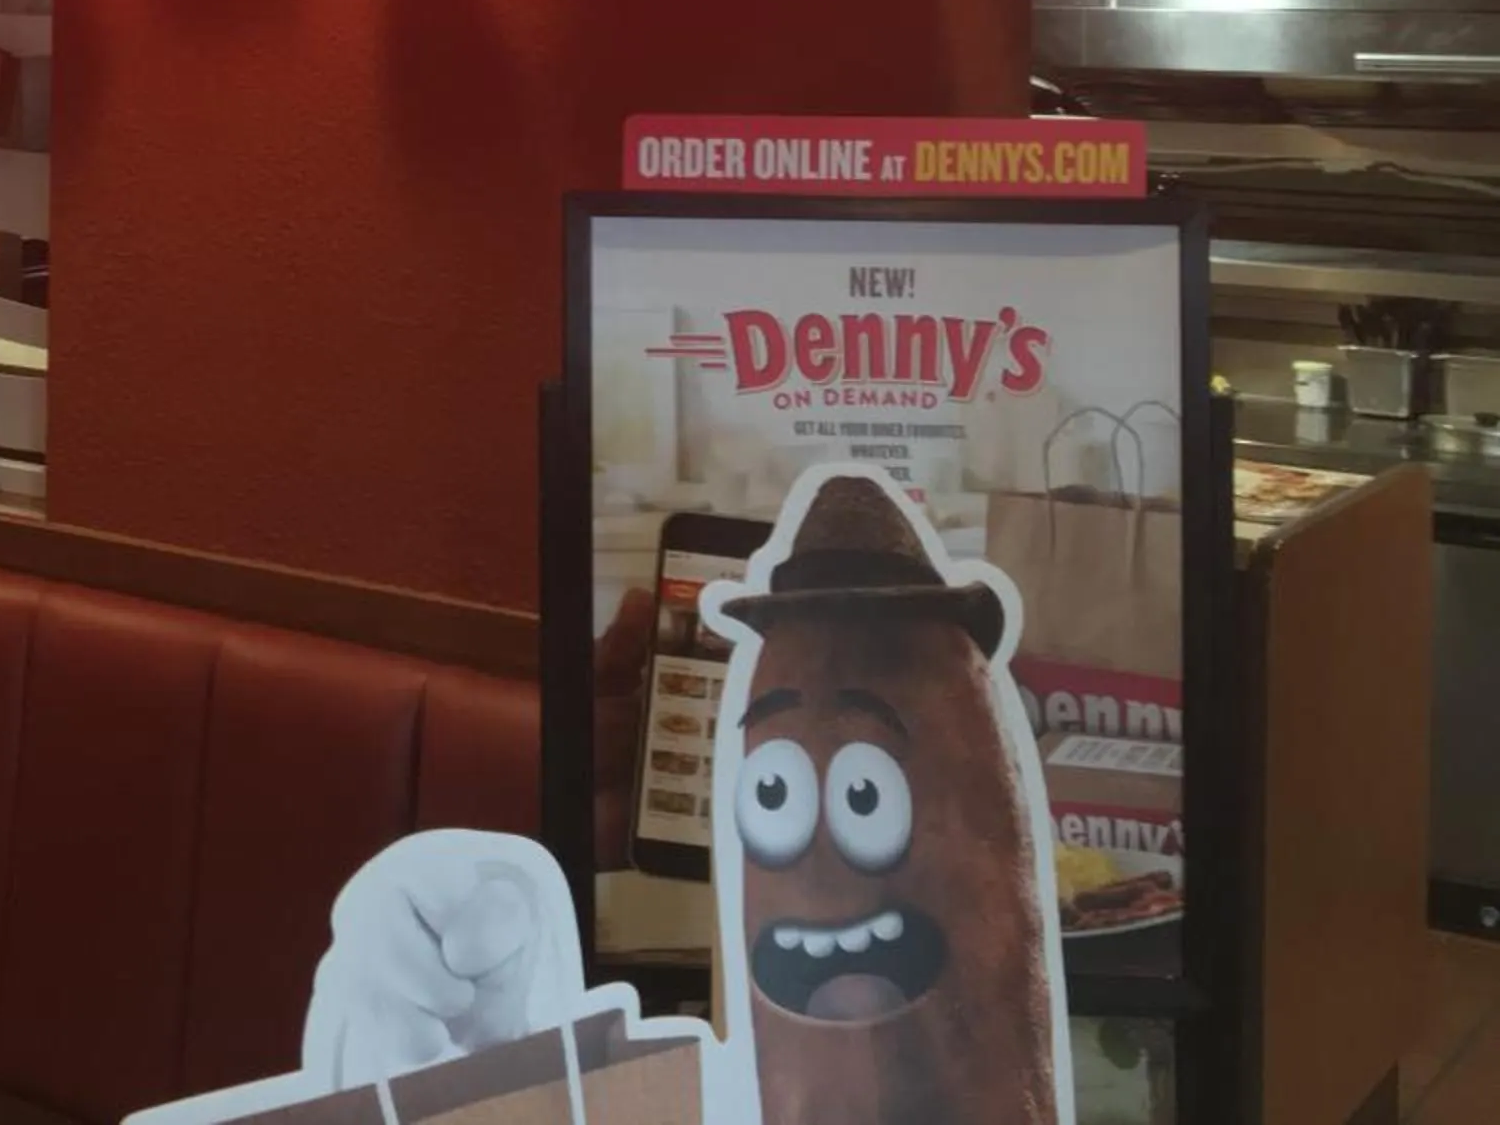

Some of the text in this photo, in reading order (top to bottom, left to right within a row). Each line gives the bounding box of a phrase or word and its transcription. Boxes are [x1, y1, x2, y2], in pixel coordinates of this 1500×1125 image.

[638, 137, 1131, 184] ORDER ONLINE AT DENNYS.COM
[848, 266, 916, 298] NEW!
[722, 305, 1049, 403] Denny's
[773, 387, 939, 410] ON DEMAND
[793, 420, 816, 436] GET
[817, 419, 837, 437] ALL
